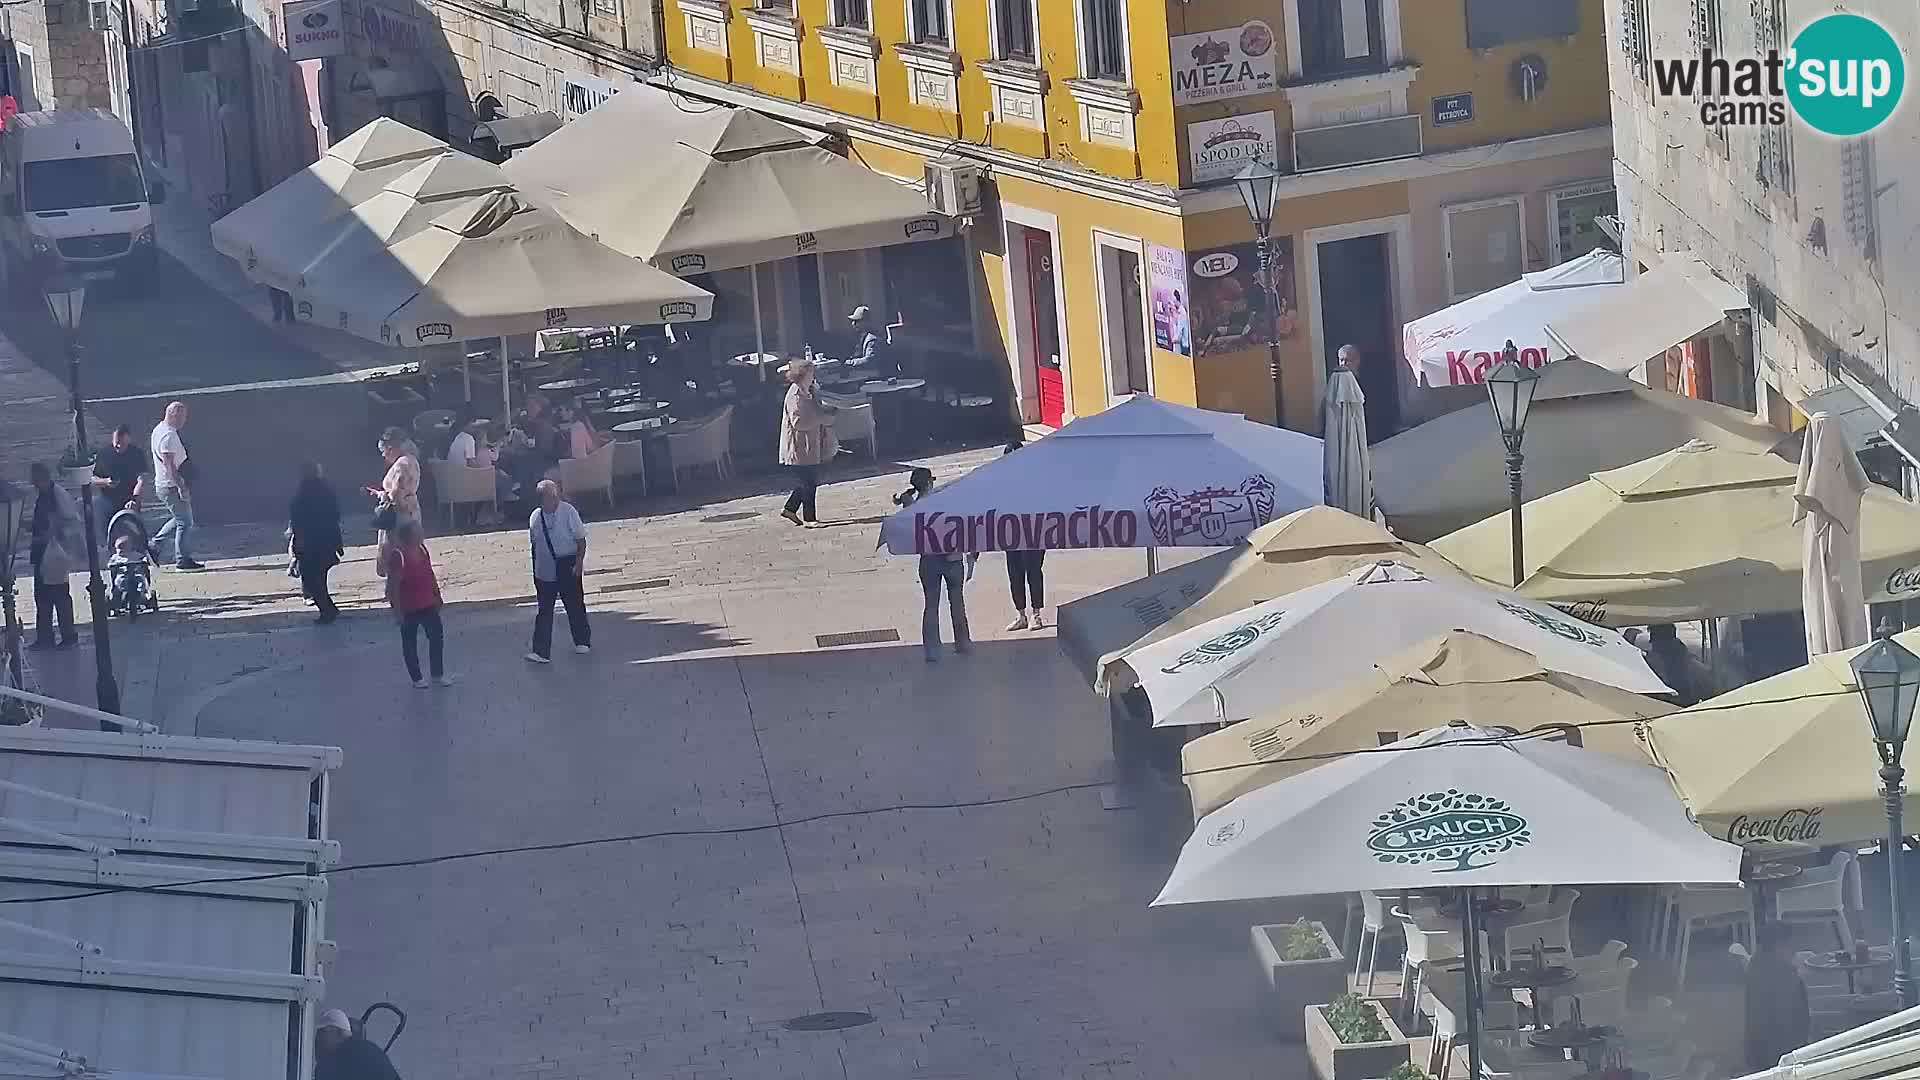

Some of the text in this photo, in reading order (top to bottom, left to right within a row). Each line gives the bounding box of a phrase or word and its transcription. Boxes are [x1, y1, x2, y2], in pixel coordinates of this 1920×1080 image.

[1176, 61, 1255, 91] MEZA
[1186, 88, 1218, 98] PIZZERIA
[1226, 83, 1247, 94] GRILL
[1195, 147, 1240, 165] ISPOD
[914, 505, 1137, 555] Karlovačko
[1408, 817, 1507, 843] RAUCH
